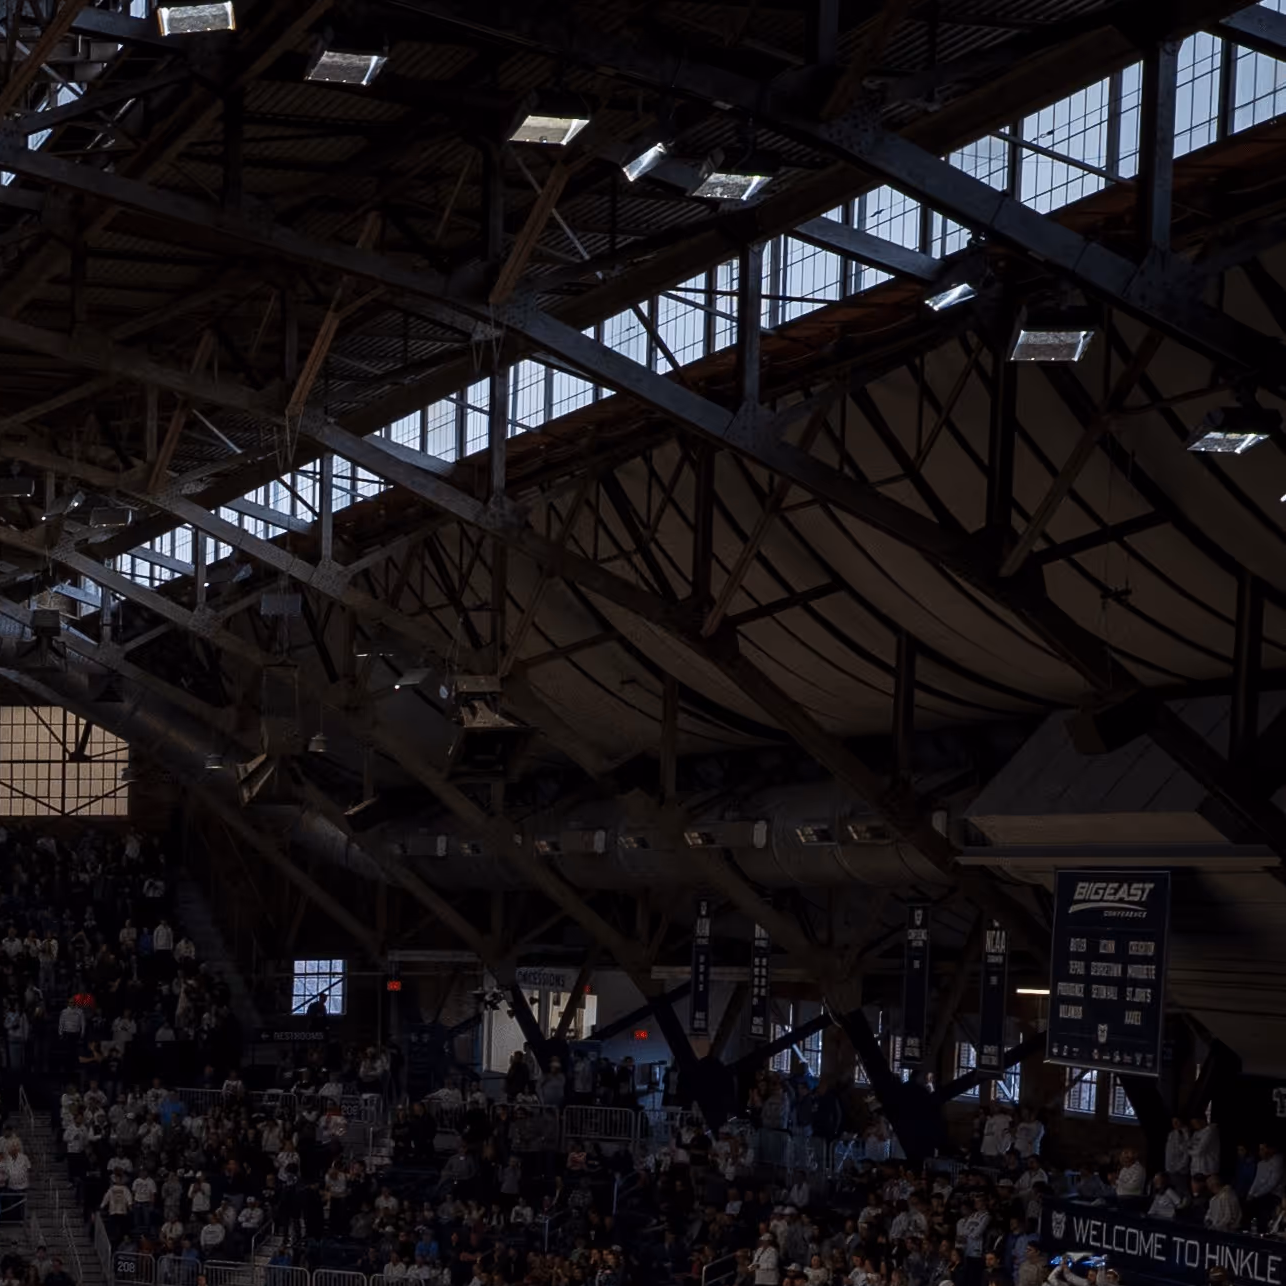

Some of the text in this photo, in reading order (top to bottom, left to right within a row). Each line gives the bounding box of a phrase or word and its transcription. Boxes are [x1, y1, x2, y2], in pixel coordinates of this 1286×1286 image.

[273, 1031, 324, 1041] RESTROOMS
[1073, 1217, 1283, 1284] WELCOME TO HINKLE
[117, 1260, 135, 1273] 208
